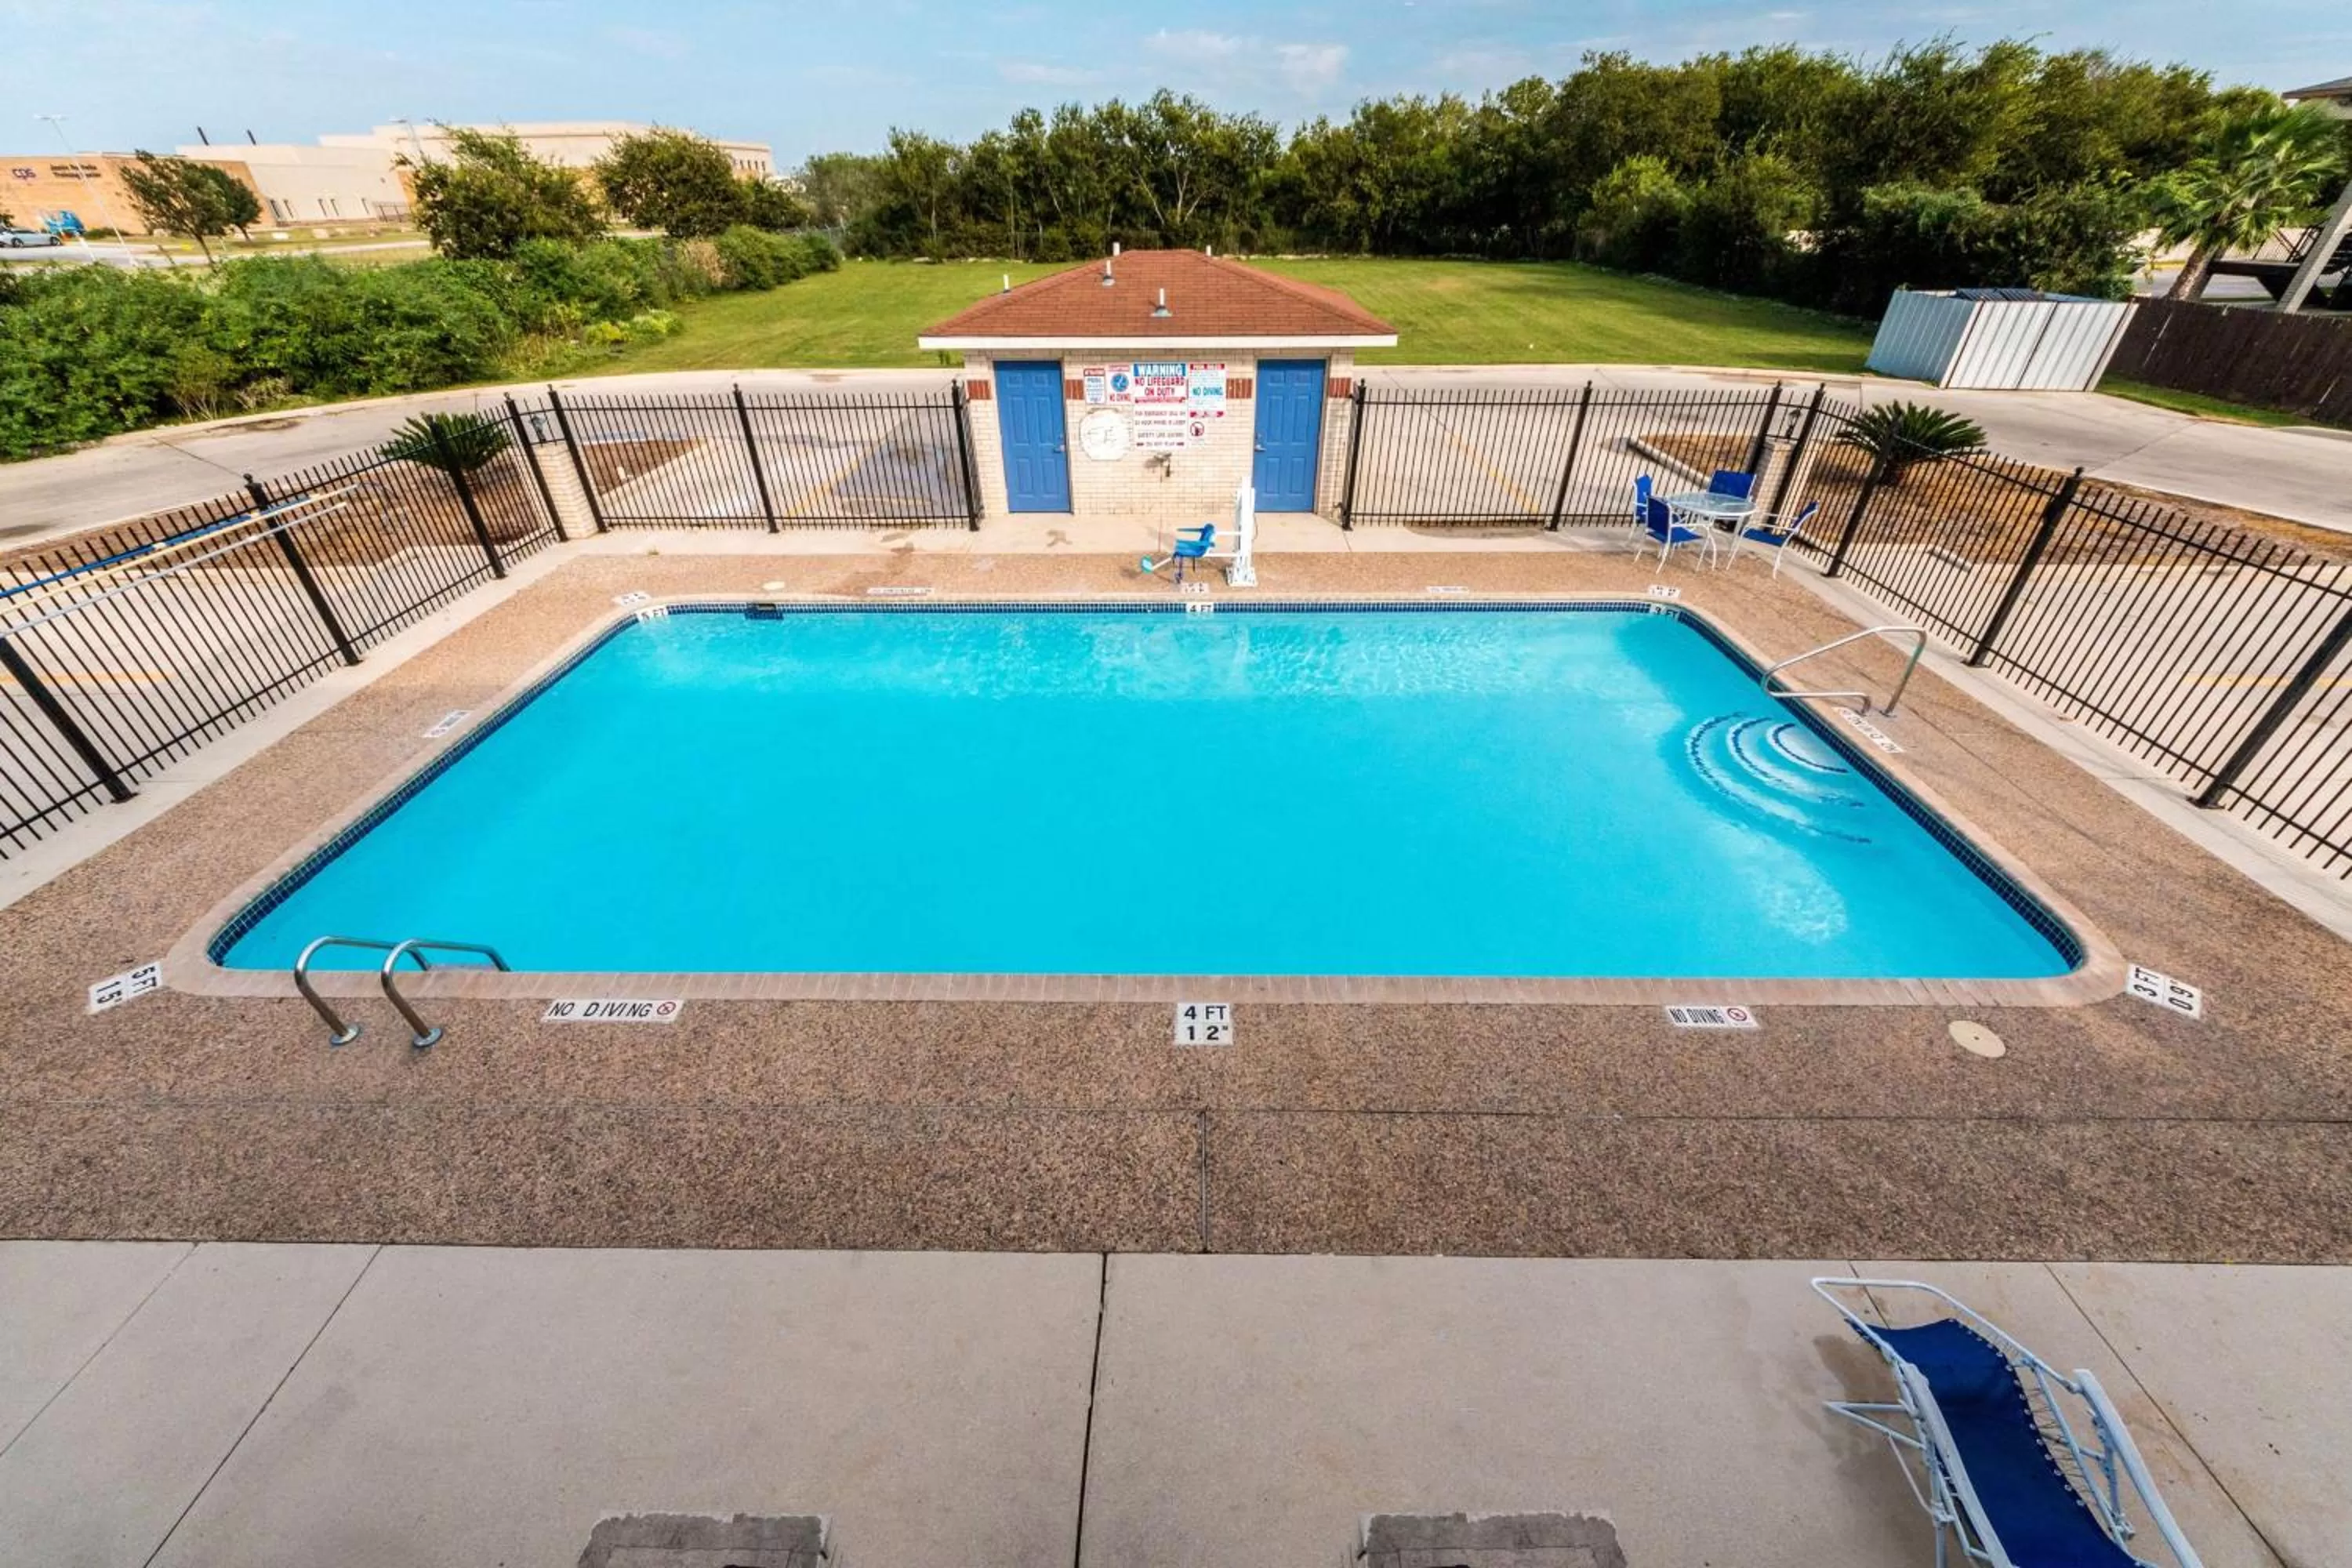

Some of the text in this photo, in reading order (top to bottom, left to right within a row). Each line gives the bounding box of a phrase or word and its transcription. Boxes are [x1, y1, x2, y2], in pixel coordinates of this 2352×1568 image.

[1139, 363, 1182, 376] WARNING
[1135, 377, 1145, 386] NO
[1147, 377, 1185, 386] LIFEGUARD
[1192, 387, 1201, 396] NO
[549, 1003, 652, 1017] NO DIVING
[1184, 1005, 1227, 1020] 4 FT
